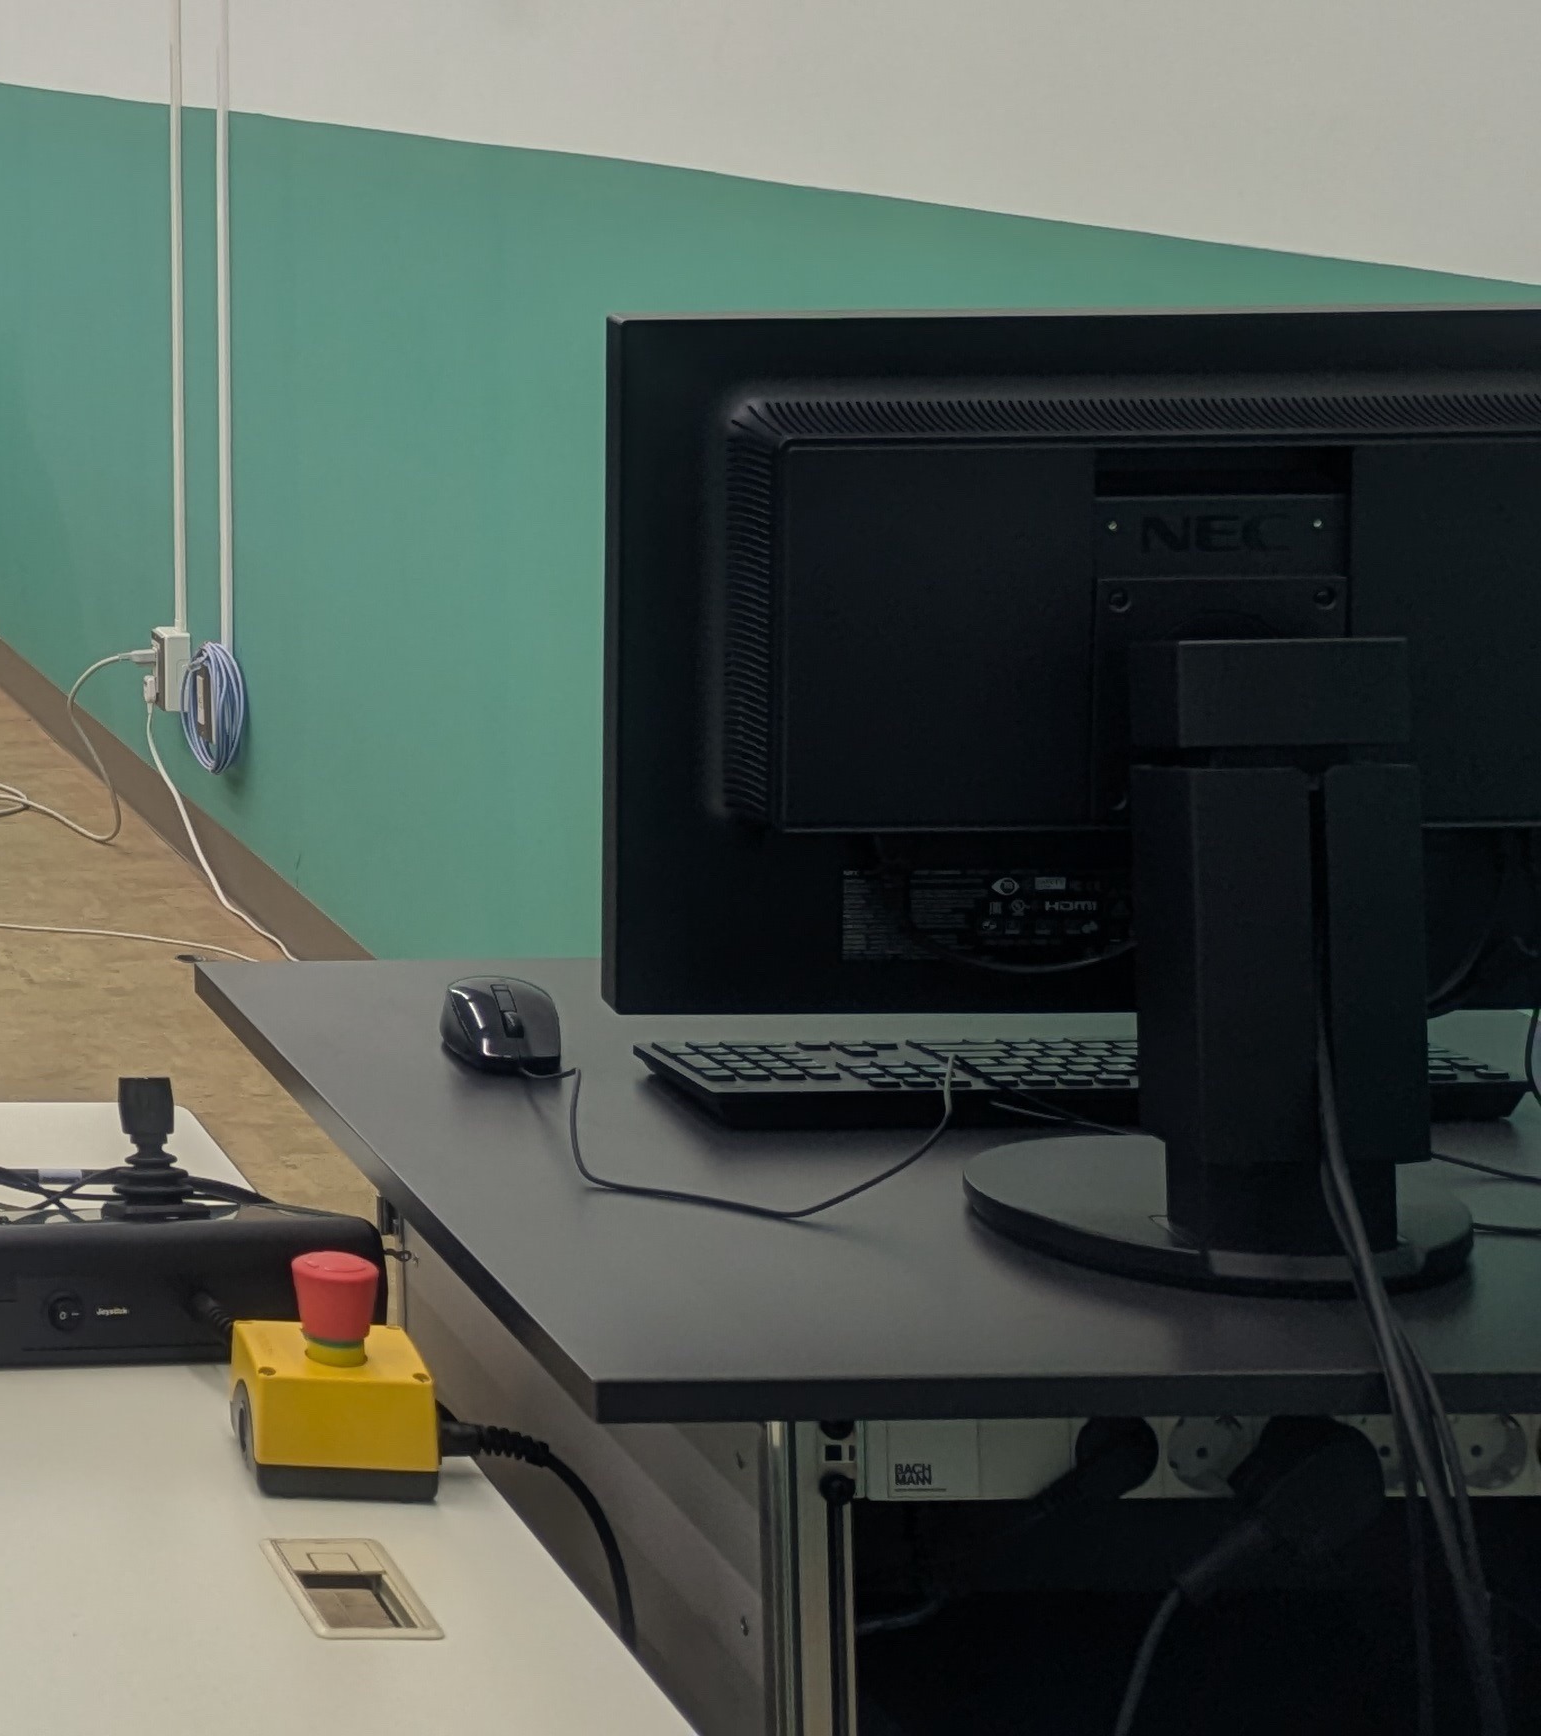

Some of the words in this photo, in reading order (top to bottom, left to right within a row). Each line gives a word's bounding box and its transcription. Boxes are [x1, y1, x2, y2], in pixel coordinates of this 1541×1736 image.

[1139, 512, 1292, 554] NEC
[1045, 901, 1097, 911] HDMI
[895, 1464, 931, 1475] BACH
[895, 1474, 931, 1485] MANN
